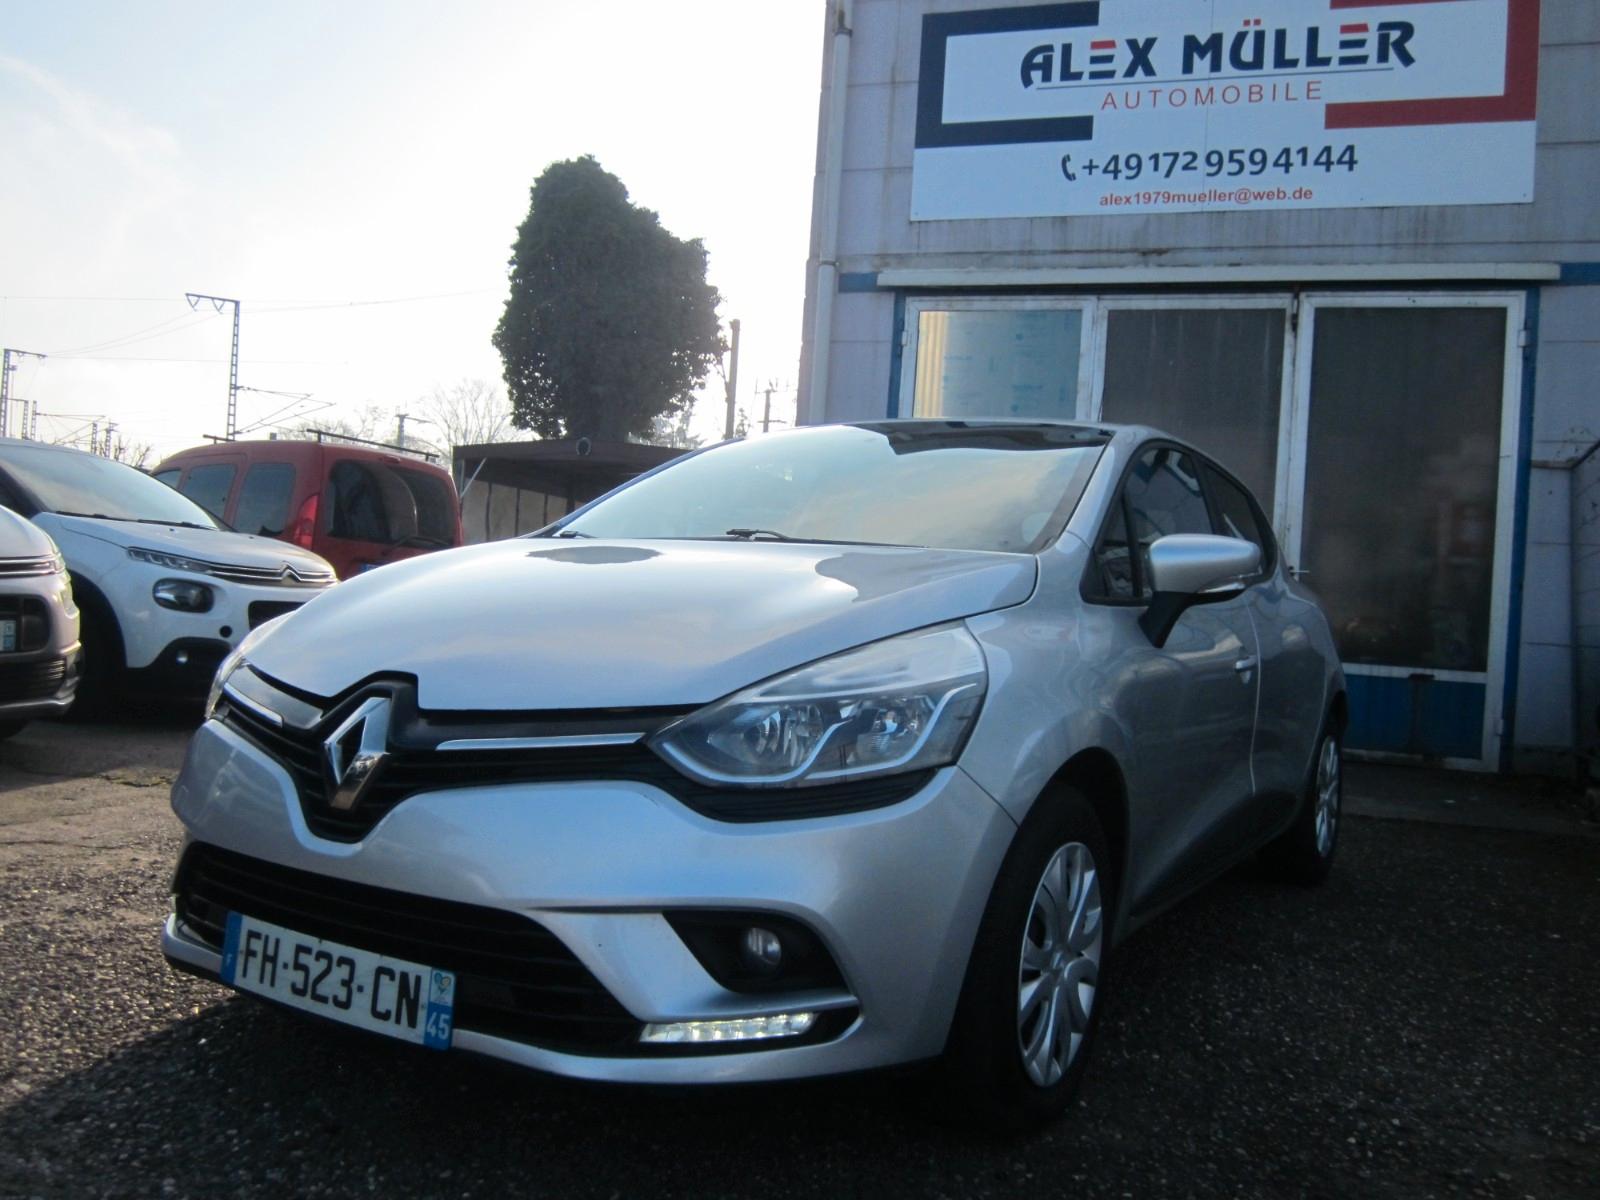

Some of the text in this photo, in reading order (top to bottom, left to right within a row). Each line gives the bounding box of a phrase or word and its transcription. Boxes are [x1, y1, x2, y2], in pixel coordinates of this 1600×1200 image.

[1020, 18, 1416, 89] ALEX MÜLLER
[1101, 80, 1323, 111] AUTOMOBILE
[1099, 187, 1313, 206] alex1979mueller@web.de
[426, 1011, 450, 1040] 45
